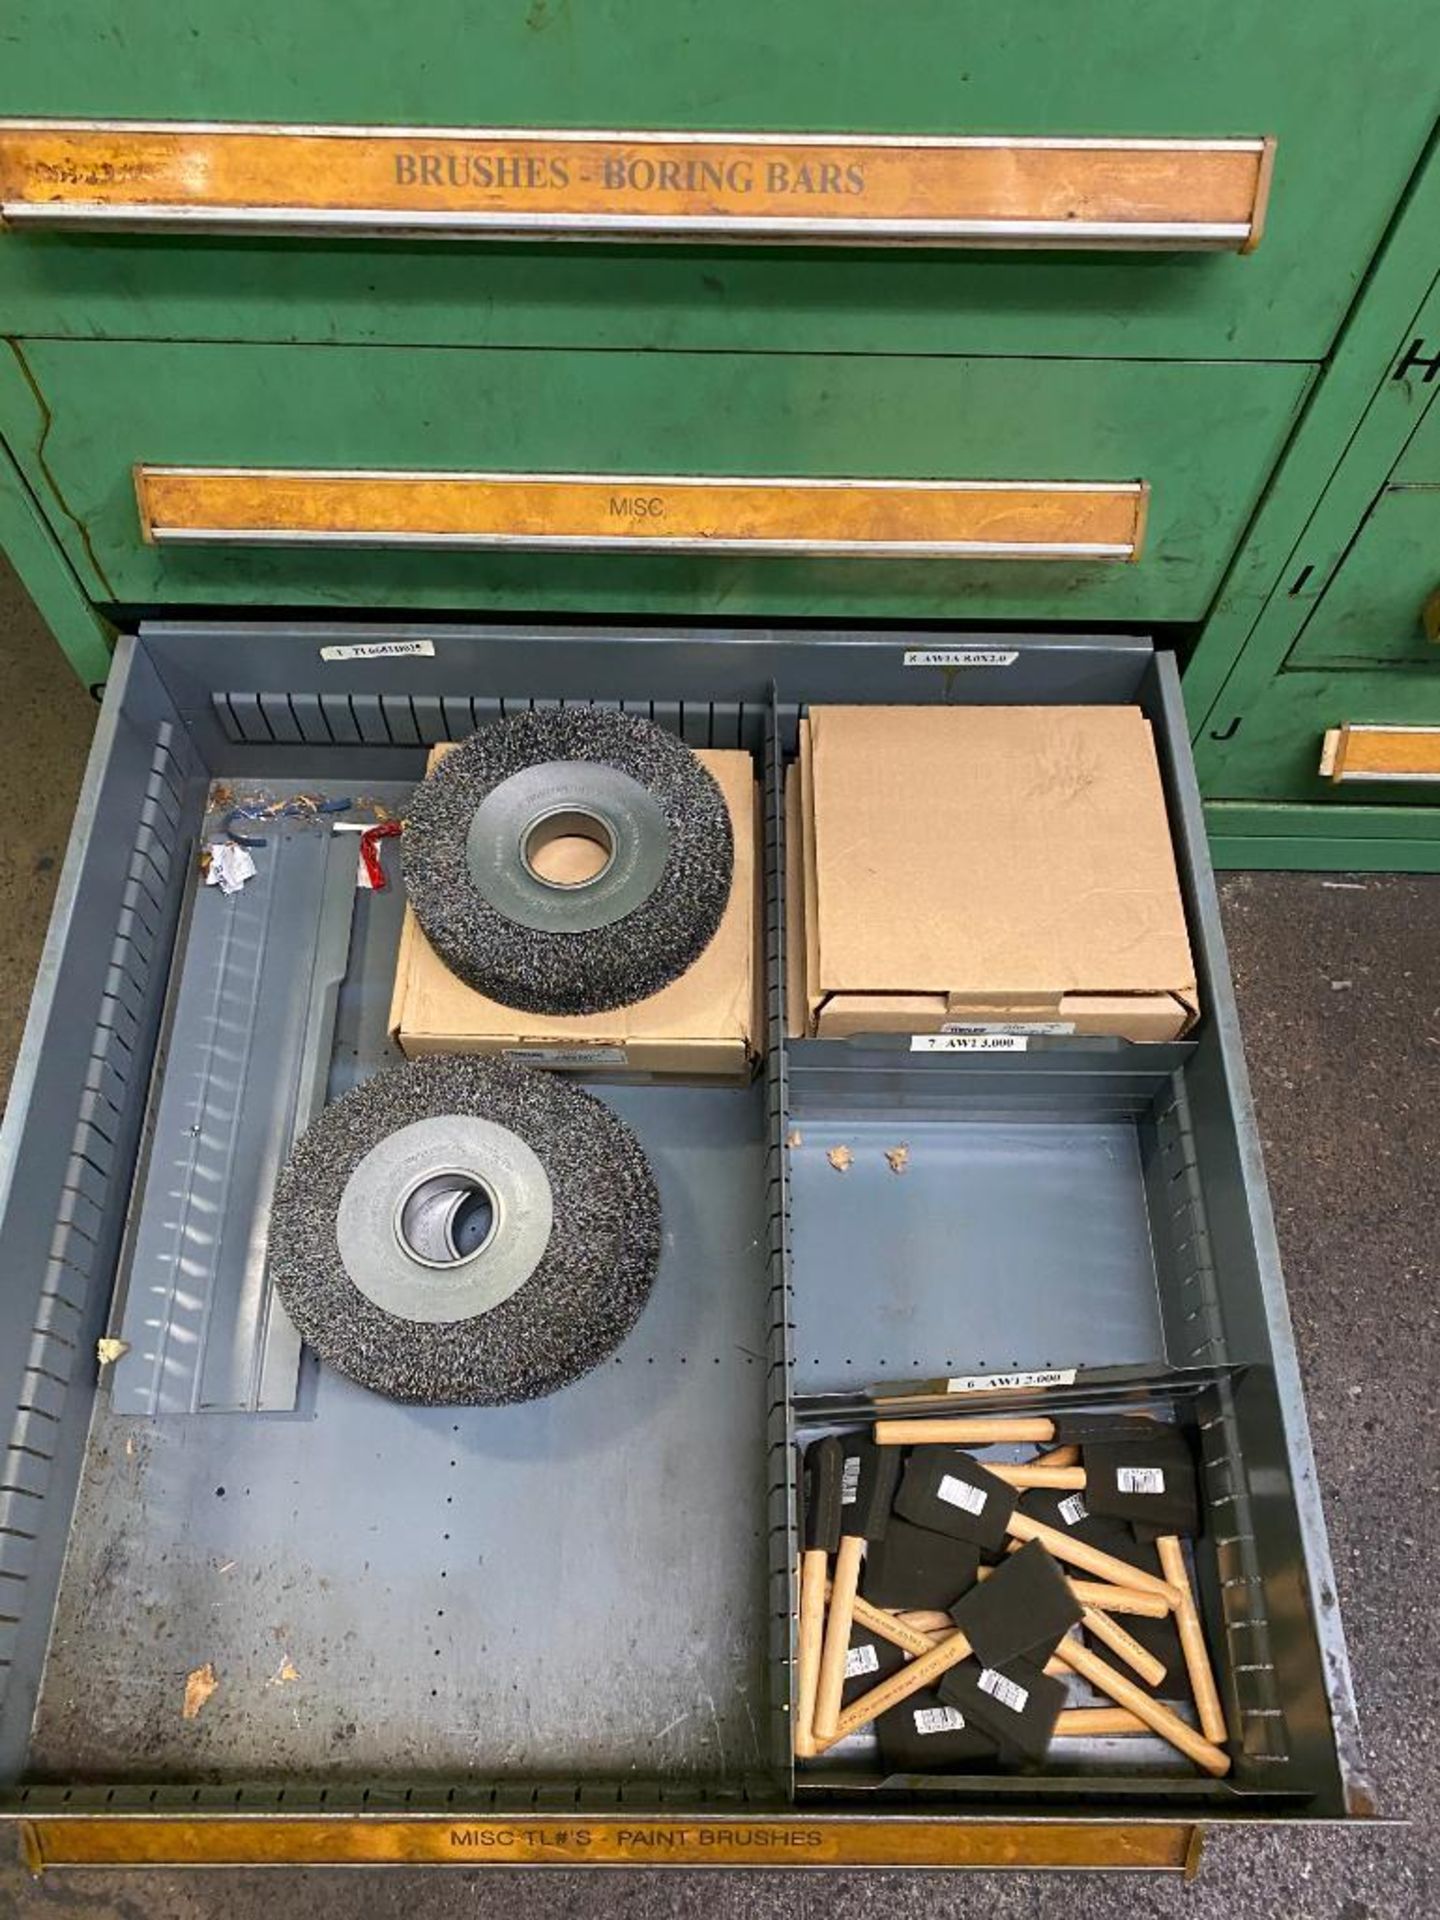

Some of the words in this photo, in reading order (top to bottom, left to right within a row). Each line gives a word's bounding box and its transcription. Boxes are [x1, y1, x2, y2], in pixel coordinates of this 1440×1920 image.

[395, 153, 570, 190] BRUSHES
[603, 155, 752, 193] BORING
[766, 161, 865, 195] BARS
[1391, 338, 1440, 382] H
[1210, 717, 1242, 741] J
[928, 1039, 936, 1048] 7
[980, 1038, 1015, 1048] 3.000
[967, 1381, 975, 1389] 6
[451, 1830, 514, 1846] MISC
[617, 1830, 689, 1847] PAINT
[700, 1829, 822, 1847] BRUSHES
